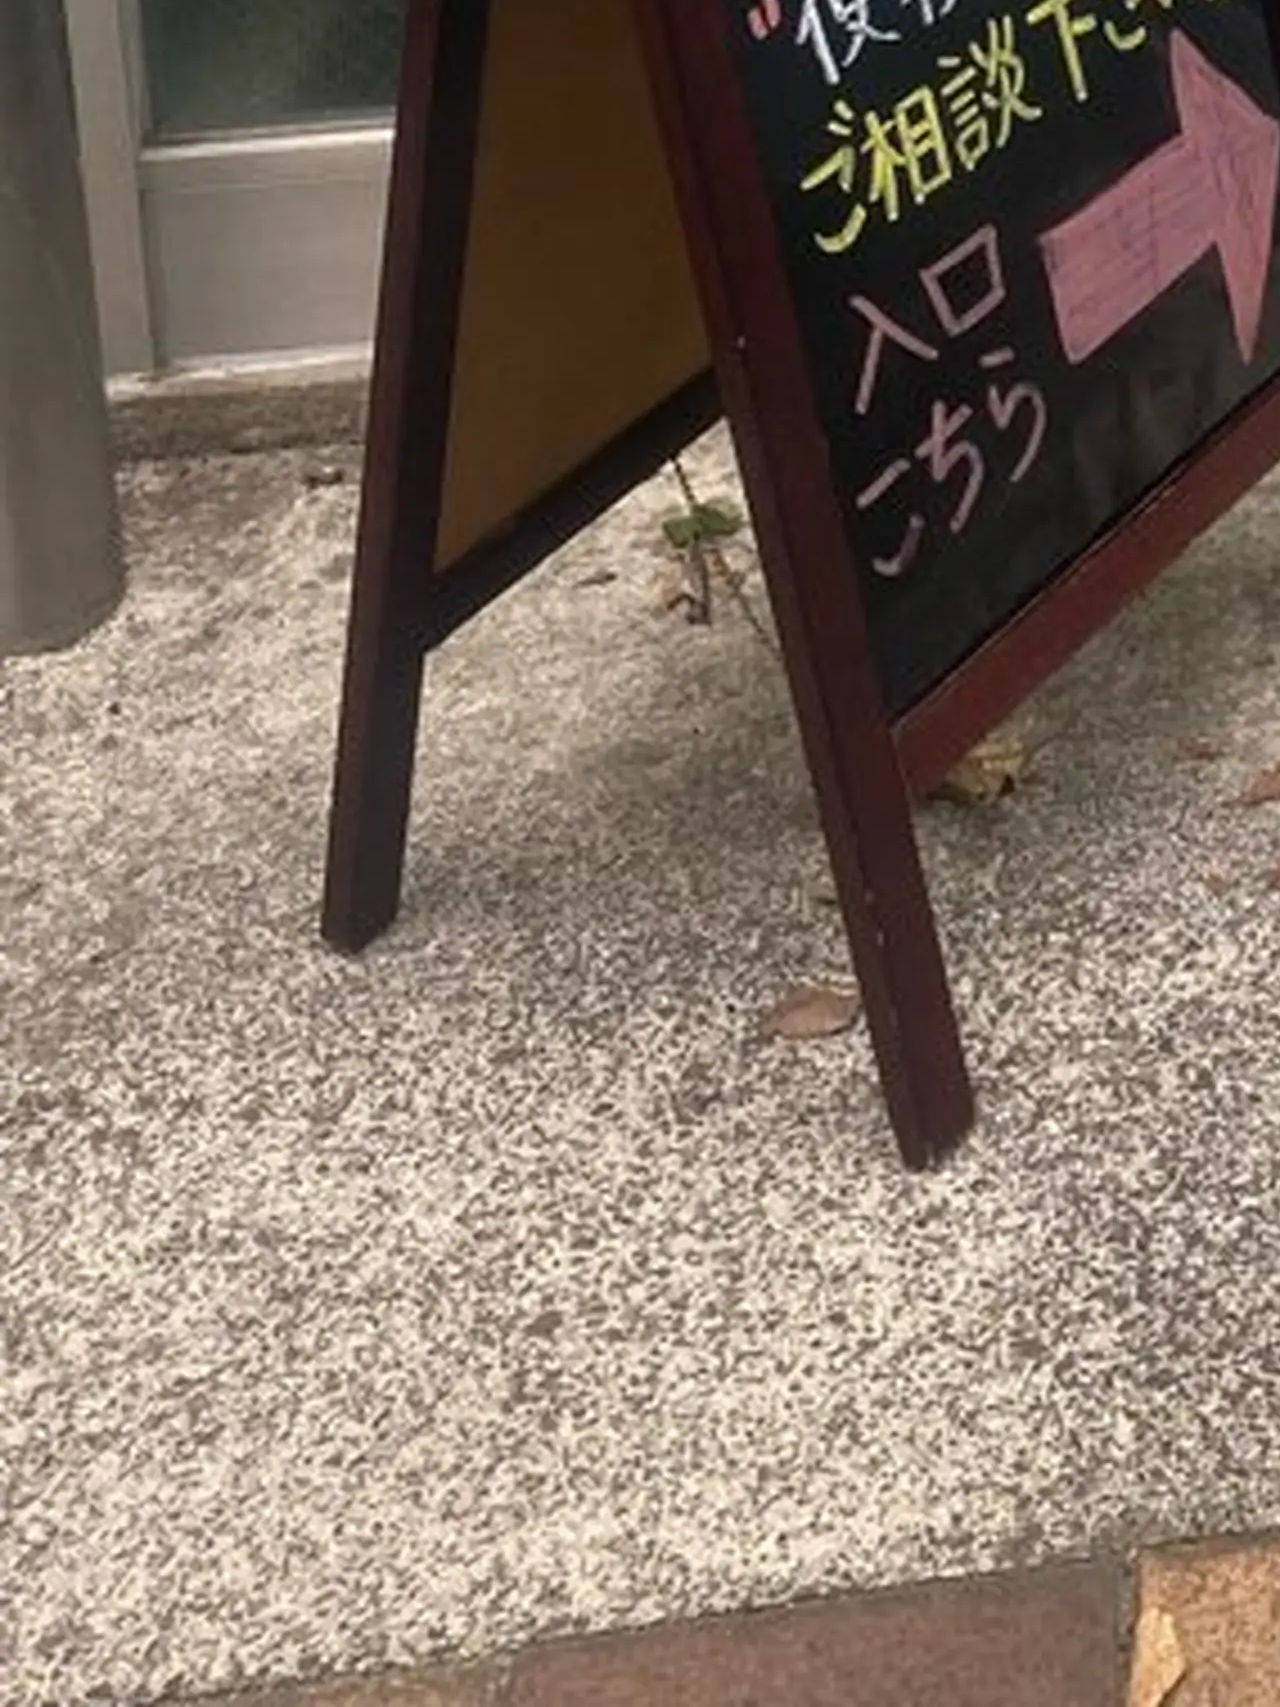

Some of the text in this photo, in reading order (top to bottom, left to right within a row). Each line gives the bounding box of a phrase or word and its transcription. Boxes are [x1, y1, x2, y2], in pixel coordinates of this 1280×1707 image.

[850, 223, 1006, 415] 入口
[856, 345, 1048, 578] こちら
